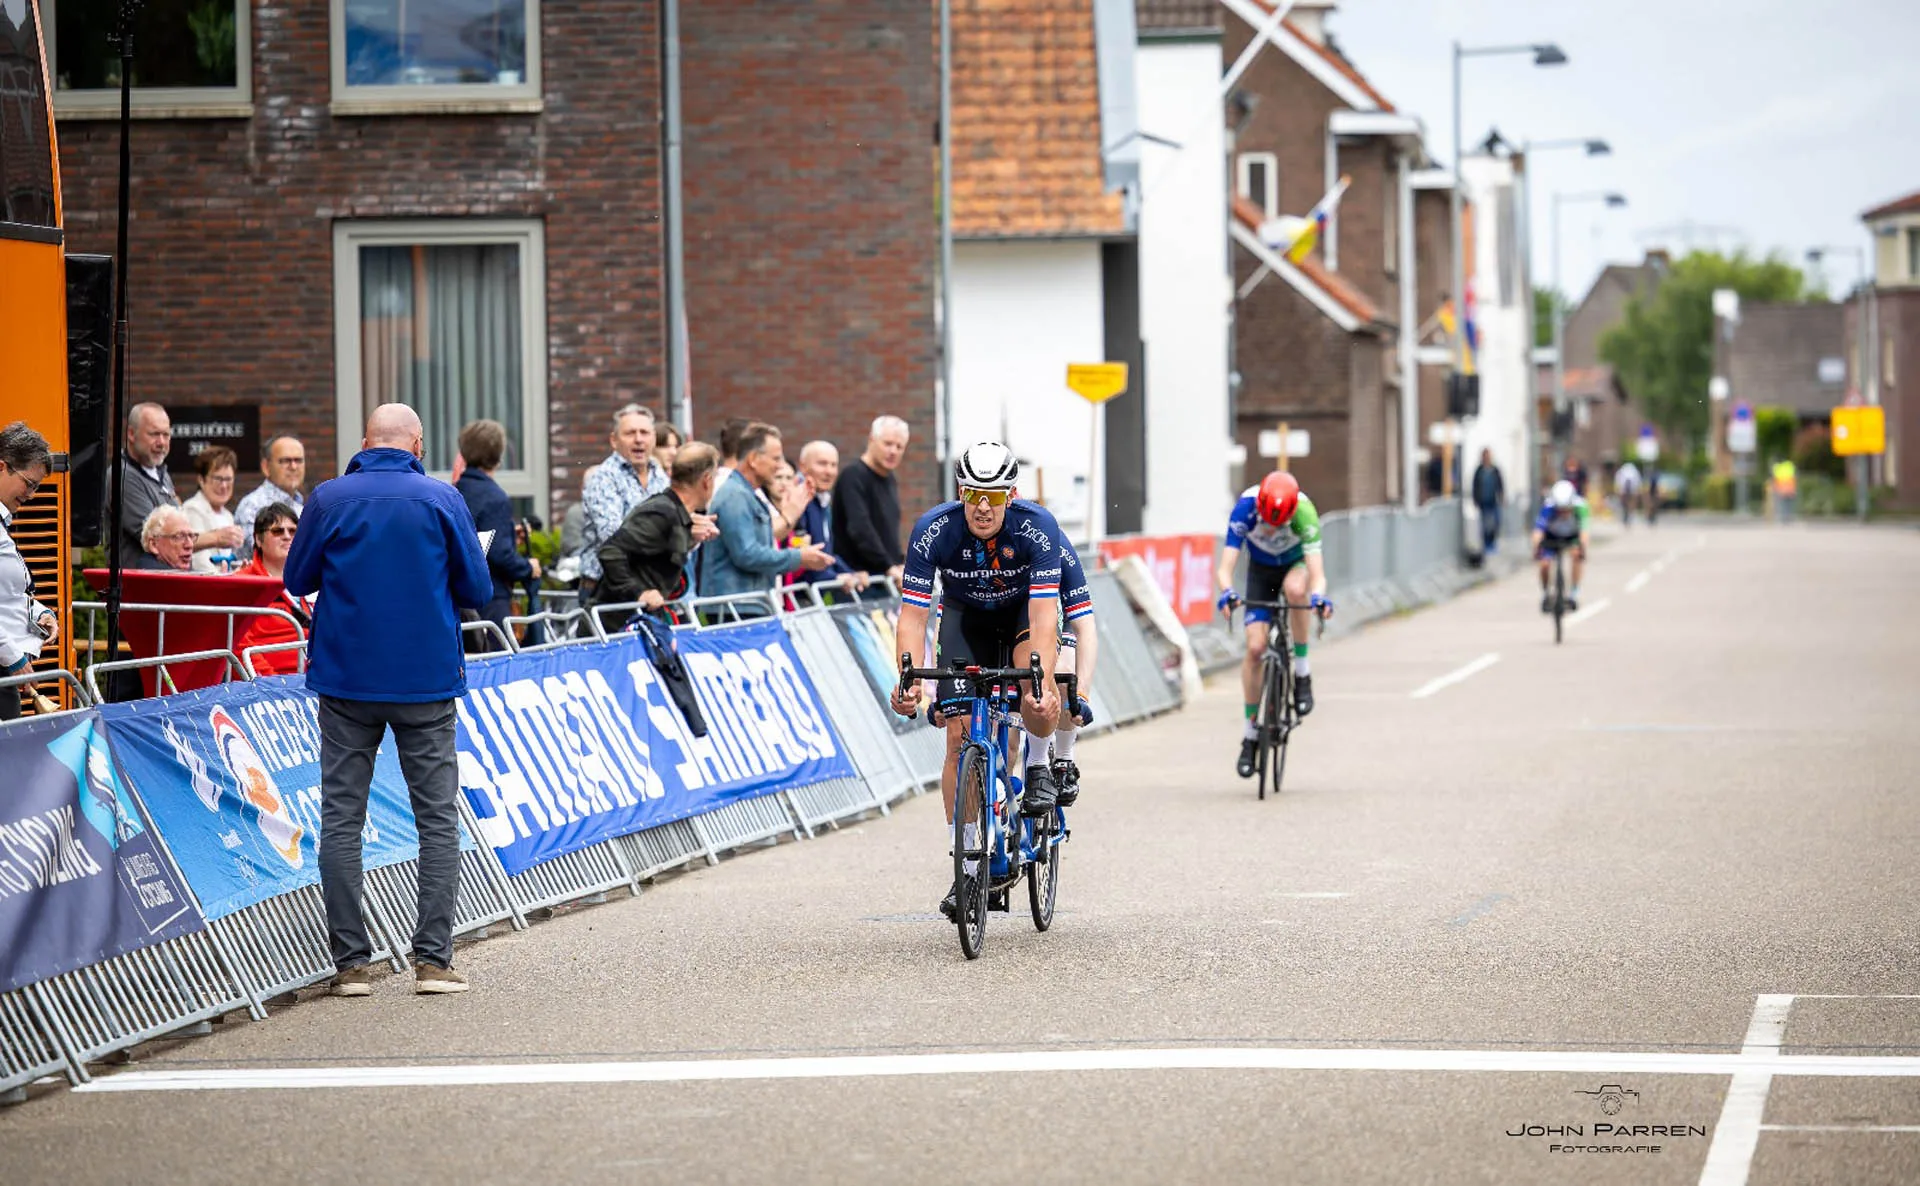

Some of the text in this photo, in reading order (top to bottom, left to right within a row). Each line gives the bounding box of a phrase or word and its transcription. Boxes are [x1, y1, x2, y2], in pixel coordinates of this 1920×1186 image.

[904, 573, 932, 587] ROEK
[627, 642, 836, 791] SHIMANO
[0, 804, 102, 888] CYCLING
